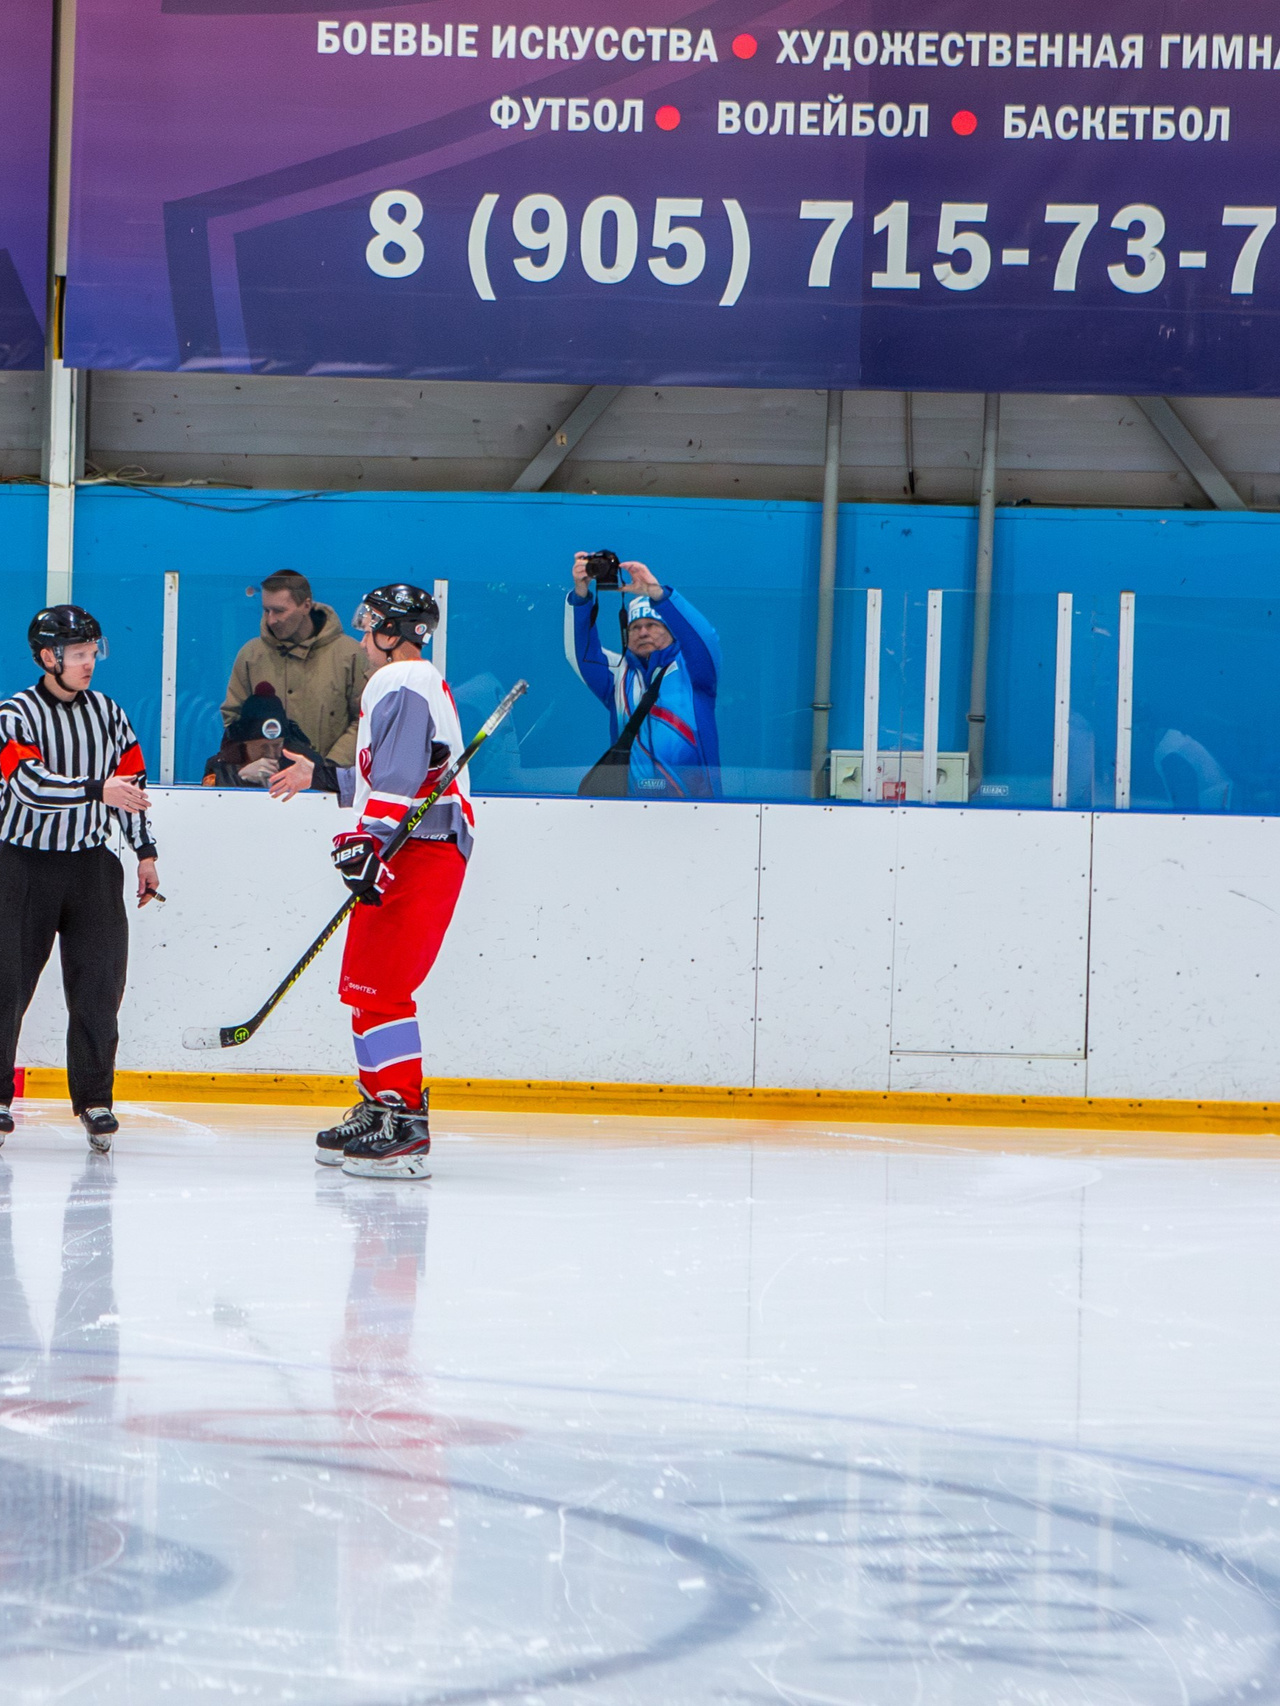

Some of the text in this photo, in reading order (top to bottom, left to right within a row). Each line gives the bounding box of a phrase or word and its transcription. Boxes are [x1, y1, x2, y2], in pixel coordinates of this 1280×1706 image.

[317, 20, 1280, 71] БОЕВЫЕ ИСКУССТВА ХУДОЖЕСТВЕННАЯ ГИМН
[490, 94, 1230, 142] ФУТБОЛ ВОЛЕЙБОЛ БАСКЕТБОЛ
[365, 189, 1277, 306] 8 (905) 715-73-7
[407, 791, 438, 831] ALPHA
